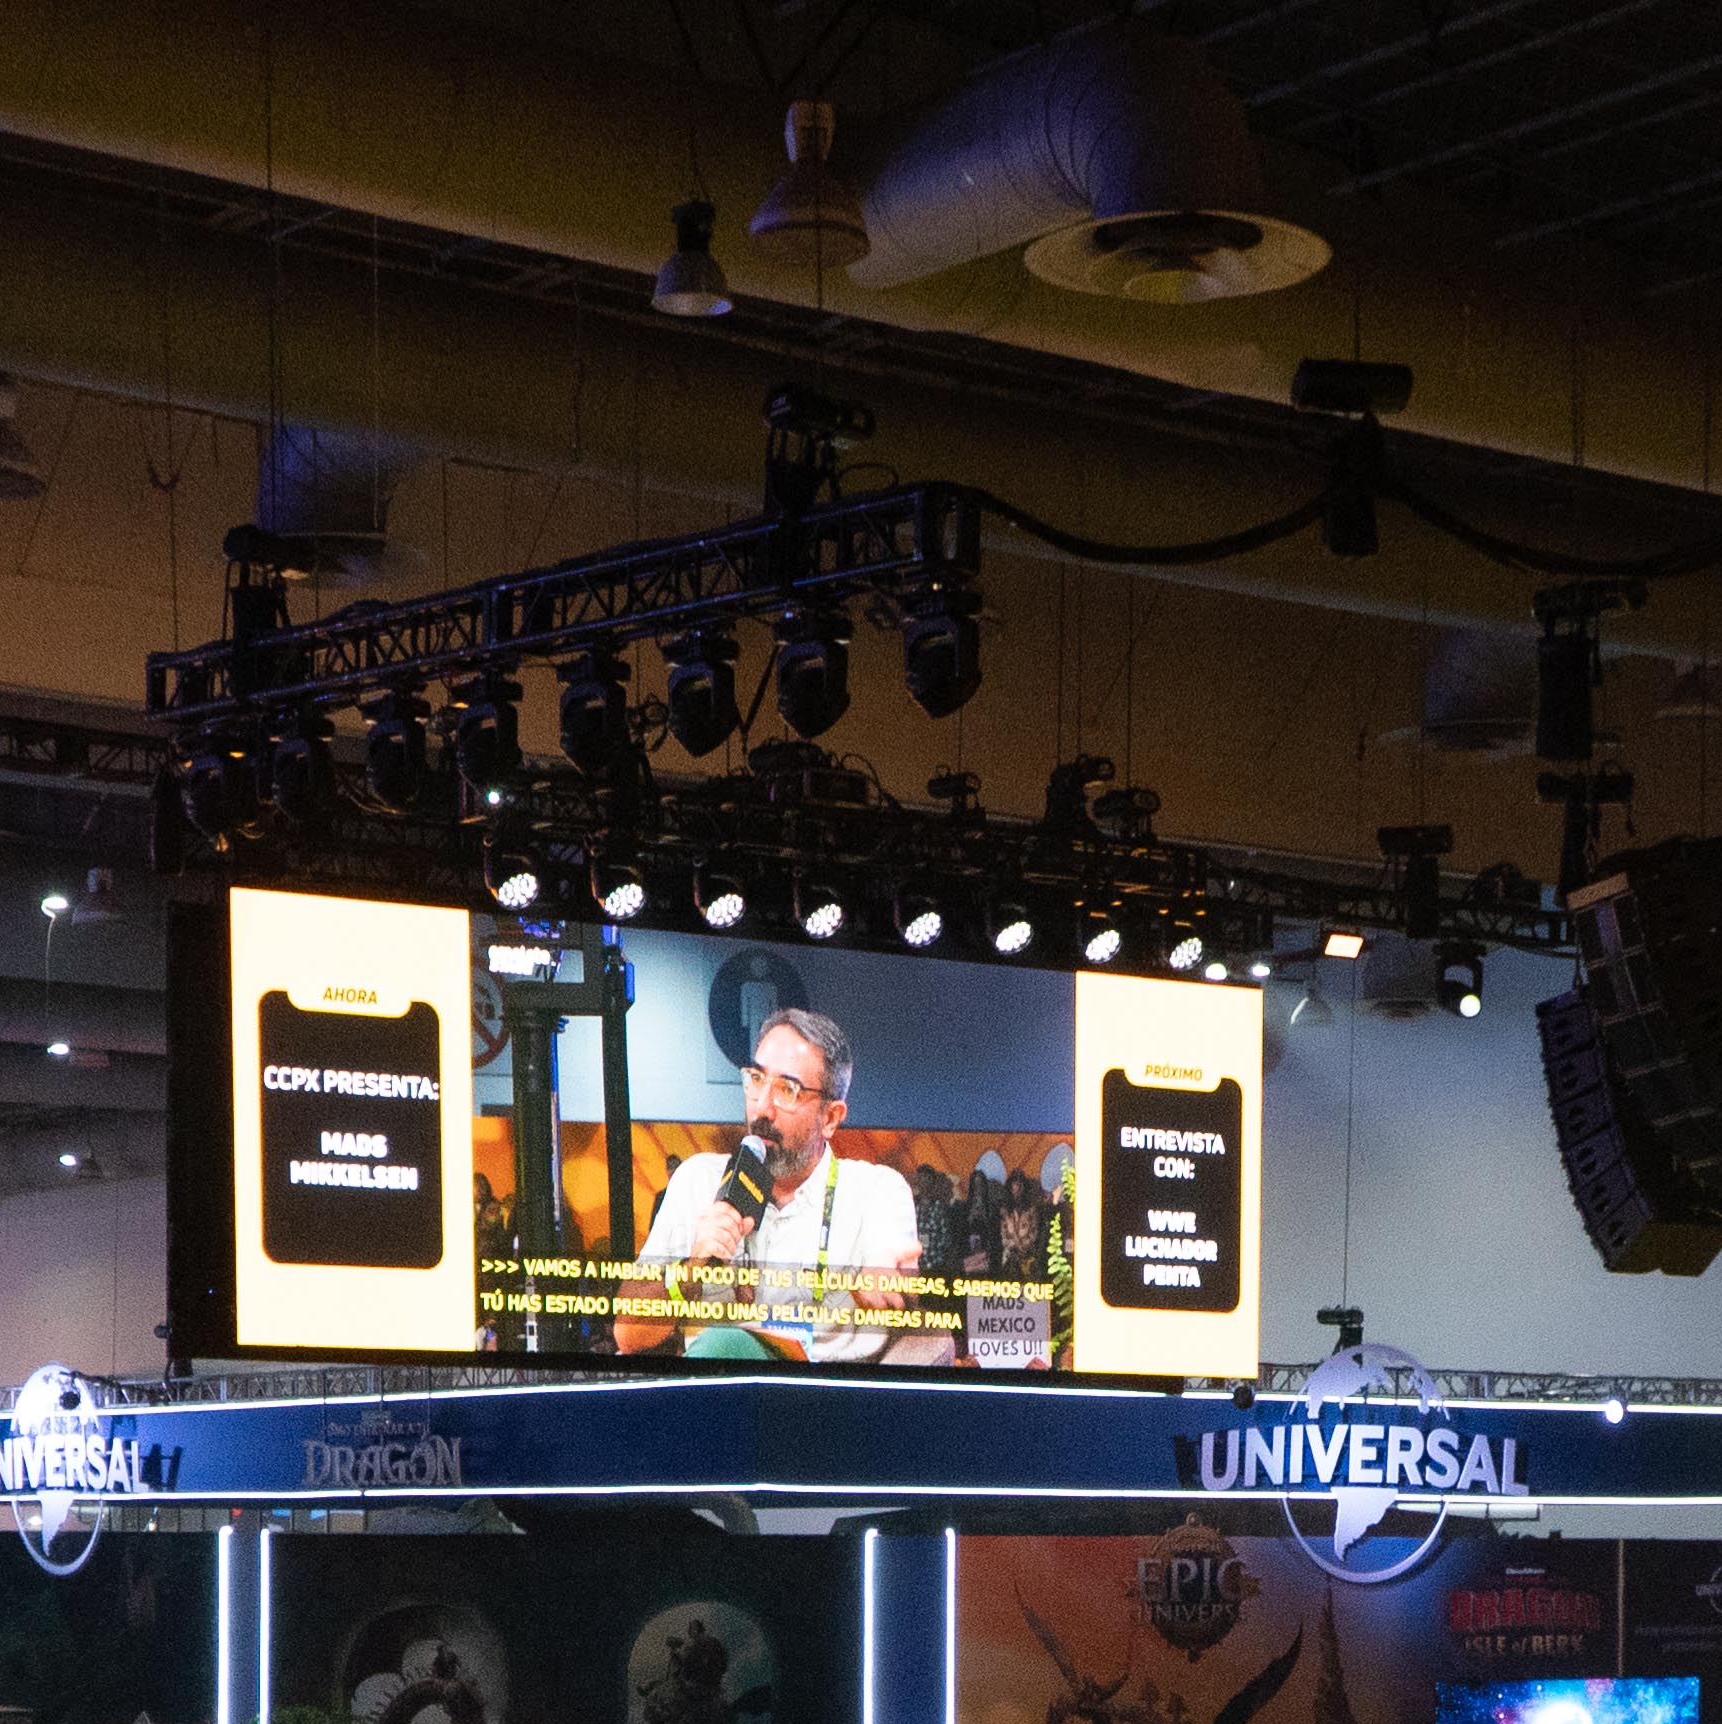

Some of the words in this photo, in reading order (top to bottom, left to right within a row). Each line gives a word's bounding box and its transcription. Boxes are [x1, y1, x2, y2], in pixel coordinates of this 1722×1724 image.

[323, 986, 378, 1005] AHORA
[263, 1065, 320, 1092] CCPX
[323, 1069, 439, 1100] PRESENTA:
[1144, 1064, 1203, 1082] PRÓXIMO
[320, 1131, 388, 1158] MADS
[1120, 1126, 1226, 1155] ENTREVISTA
[289, 1160, 419, 1190] MIKKELSEN
[1154, 1156, 1195, 1179] CON:
[1148, 1209, 1196, 1234] WWE
[1125, 1235, 1218, 1262] LUCHADOR
[523, 1258, 581, 1278] VAMOS
[584, 1261, 598, 1278] A
[600, 1259, 663, 1281] HABLAR
[665, 1262, 689, 1282] UN
[692, 1265, 735, 1284] POCO
[737, 1268, 759, 1286] DE
[763, 1269, 793, 1287] TUS
[796, 1268, 874, 1292] PELÍCULAS
[878, 1276, 950, 1298] DANESAS,
[952, 1278, 1023, 1299] SABEMOS
[1023, 1282, 1055, 1302] QUE
[1143, 1264, 1201, 1288] PENTA
[480, 1288, 504, 1312] TÚ
[507, 1294, 542, 1312] HAS
[545, 1294, 610, 1315] ESTADO
[612, 1298, 724, 1321] PRESENTANDO
[727, 1303, 769, 1322] UNAS
[771, 1302, 851, 1325] PELÍCULAS
[853, 1310, 922, 1329] DANESAS
[924, 1312, 962, 1330] PARA
[981, 1295, 1025, 1312] MADS
[977, 1316, 1036, 1334] MEXICO
[972, 1341, 1022, 1356] LOVES
[1023, 1340, 1043, 1356] U!!
[1200, 1423, 1529, 1496] UNIVERSAL
[1137, 1557, 1248, 1602] EPIC
[1464, 1635, 1508, 1653] ISLE
[1530, 1633, 1585, 1655] BERK
